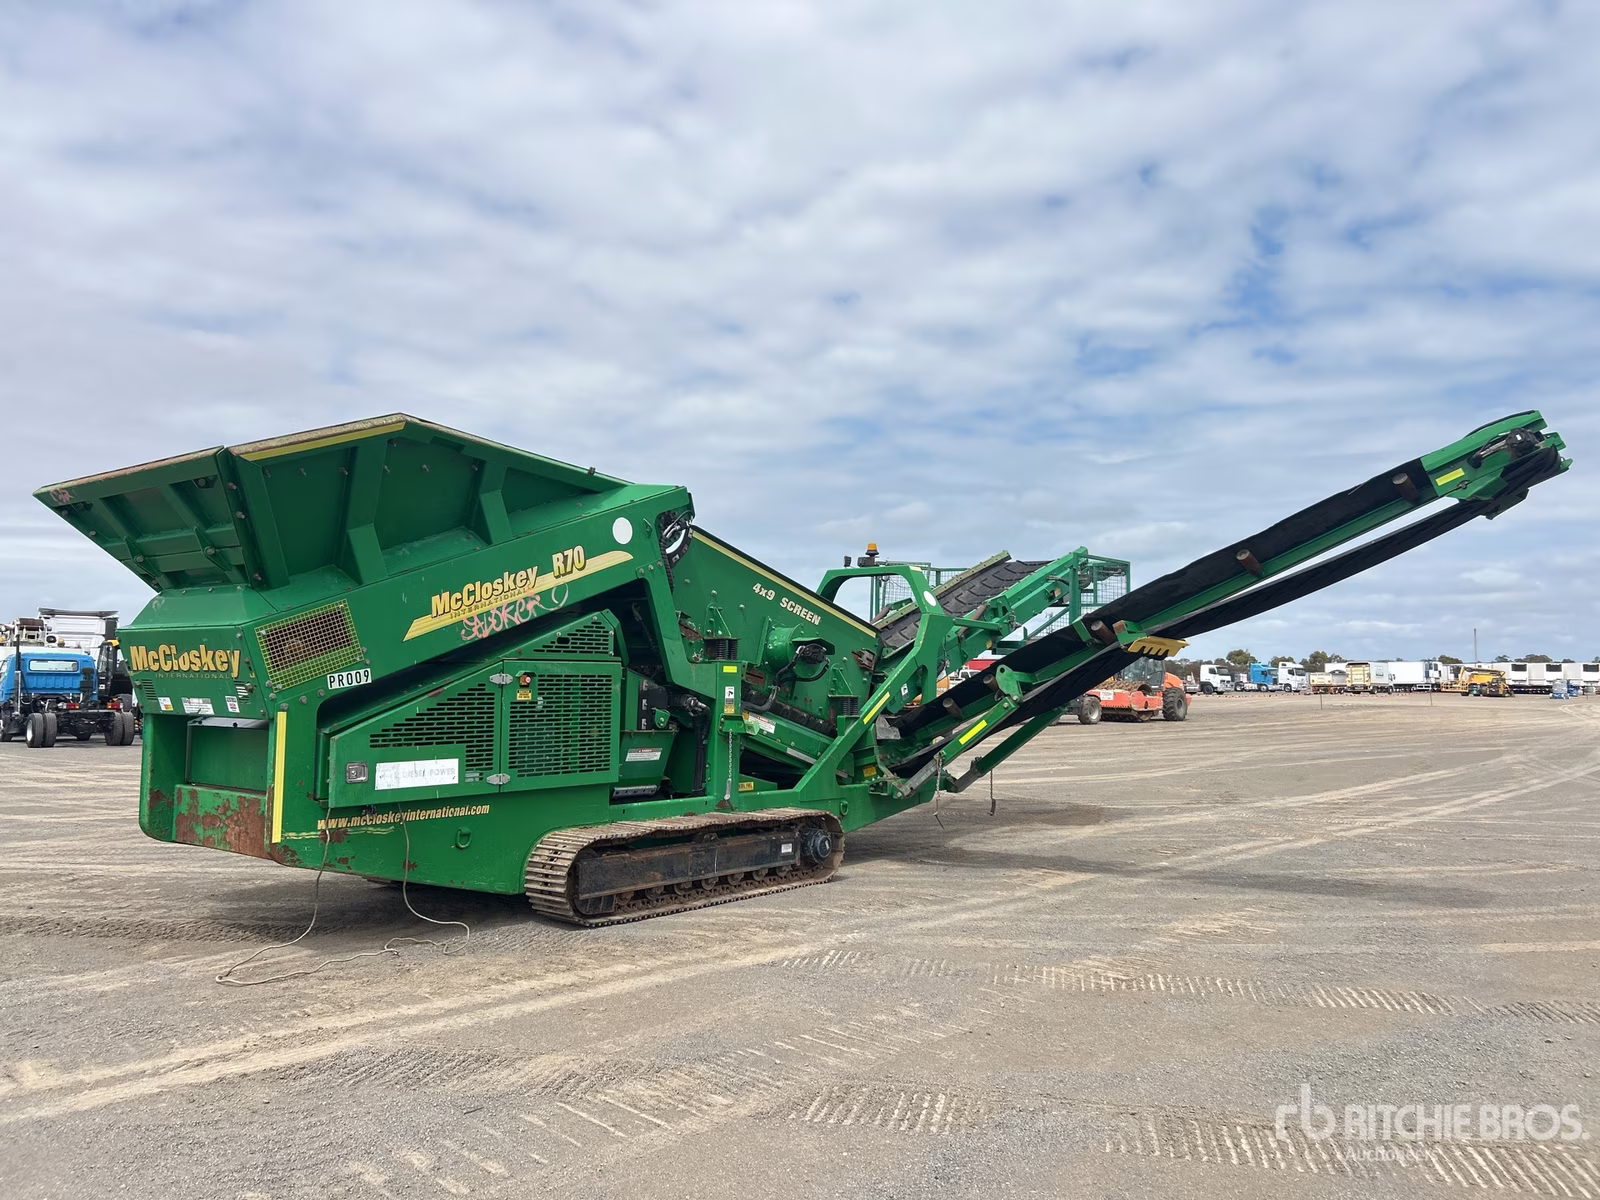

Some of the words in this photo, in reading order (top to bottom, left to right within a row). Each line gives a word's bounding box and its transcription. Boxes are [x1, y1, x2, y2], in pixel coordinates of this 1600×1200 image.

[552, 545, 587, 579] R70
[431, 565, 540, 618] McCloskey
[450, 587, 530, 619] INTERNATIONAL
[753, 582, 775, 600] 4x9
[779, 597, 821, 625] SCREEN
[130, 644, 240, 679] McCloskey
[329, 670, 369, 688] PR009
[429, 767, 456, 777] POWER
[317, 803, 490, 830] www.mccloskeyinternational.com
